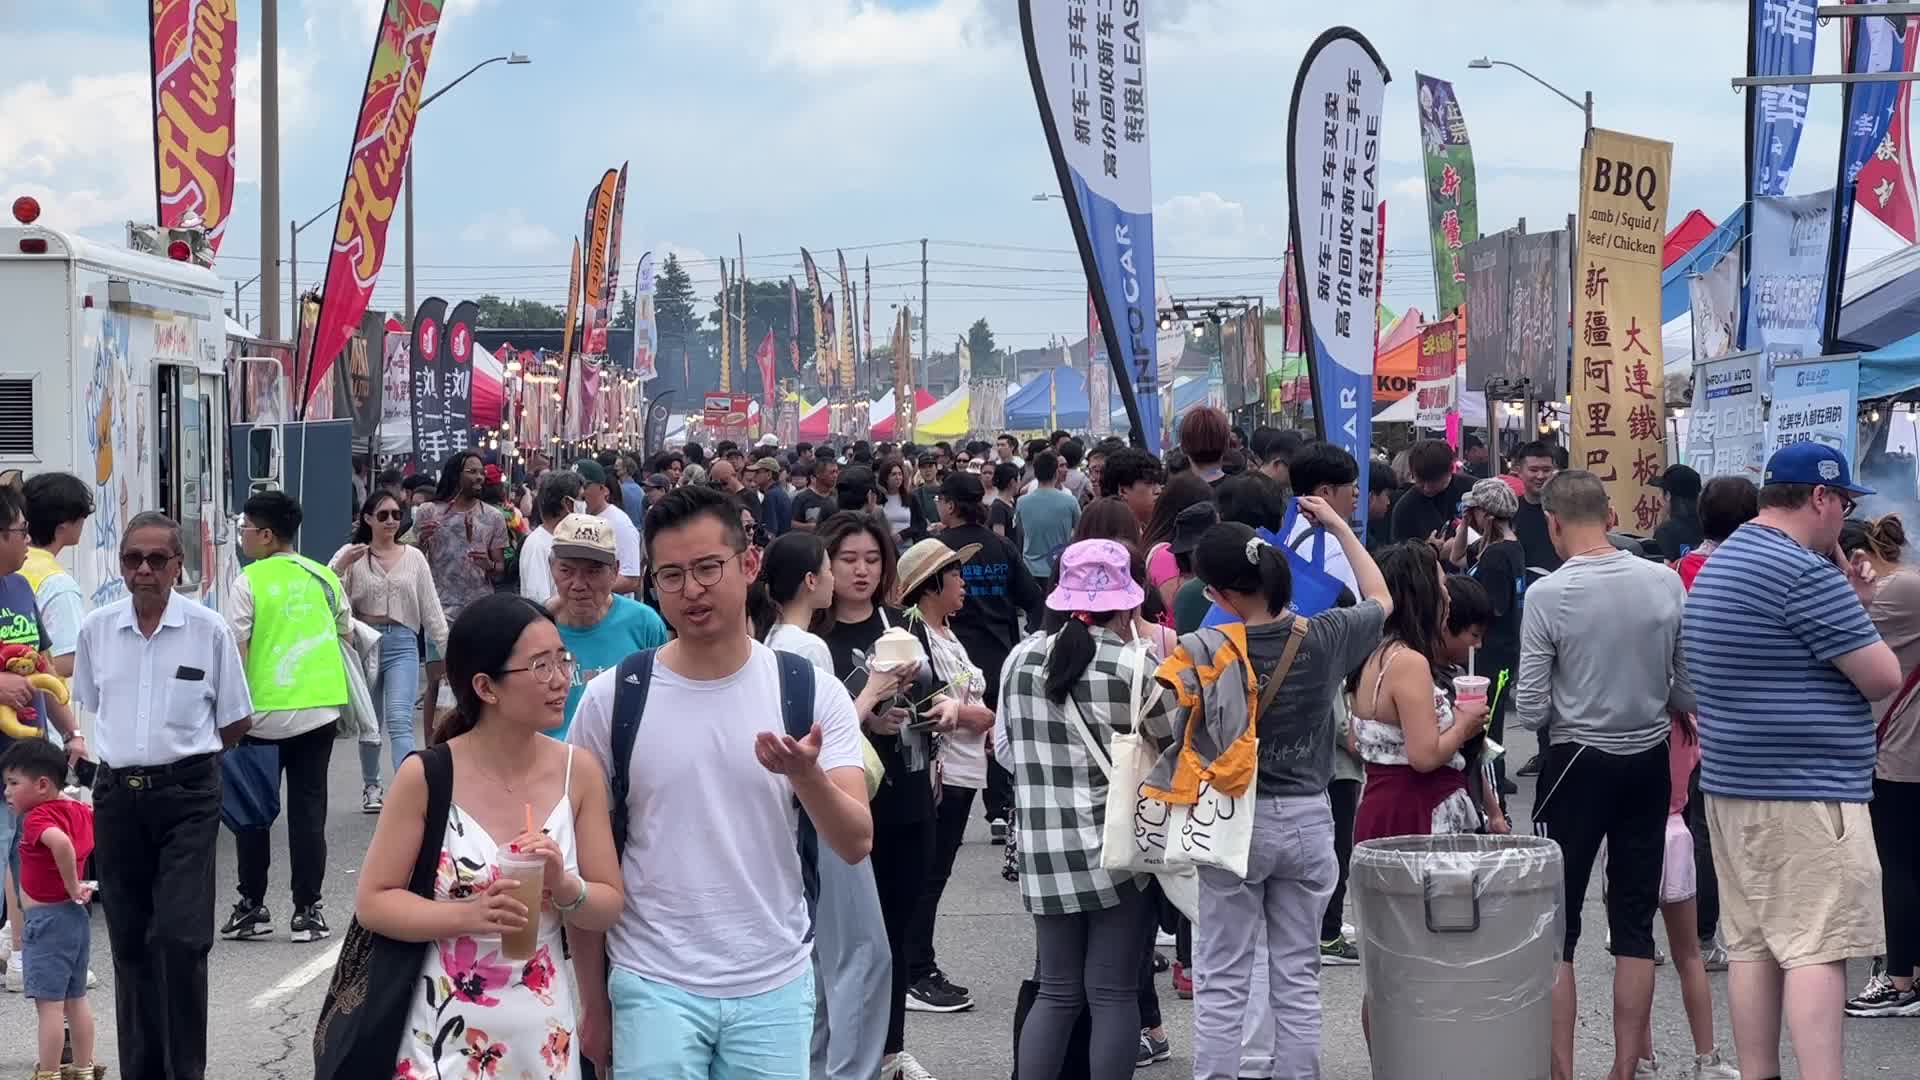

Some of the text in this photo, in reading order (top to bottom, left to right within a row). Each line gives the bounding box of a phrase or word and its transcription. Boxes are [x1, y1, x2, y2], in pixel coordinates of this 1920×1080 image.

[1066, 0, 1091, 146] 新车二手车
[1317, 92, 1340, 302] 新车二手车买卖
[1335, 67, 1362, 338] 高价回收新车二手车
[1358, 114, 1379, 298] 转接LEASE
[1593, 157, 1657, 211] BBQ
[1613, 235, 1656, 255] Chicken
[422, 365, 450, 484] 刘一手
